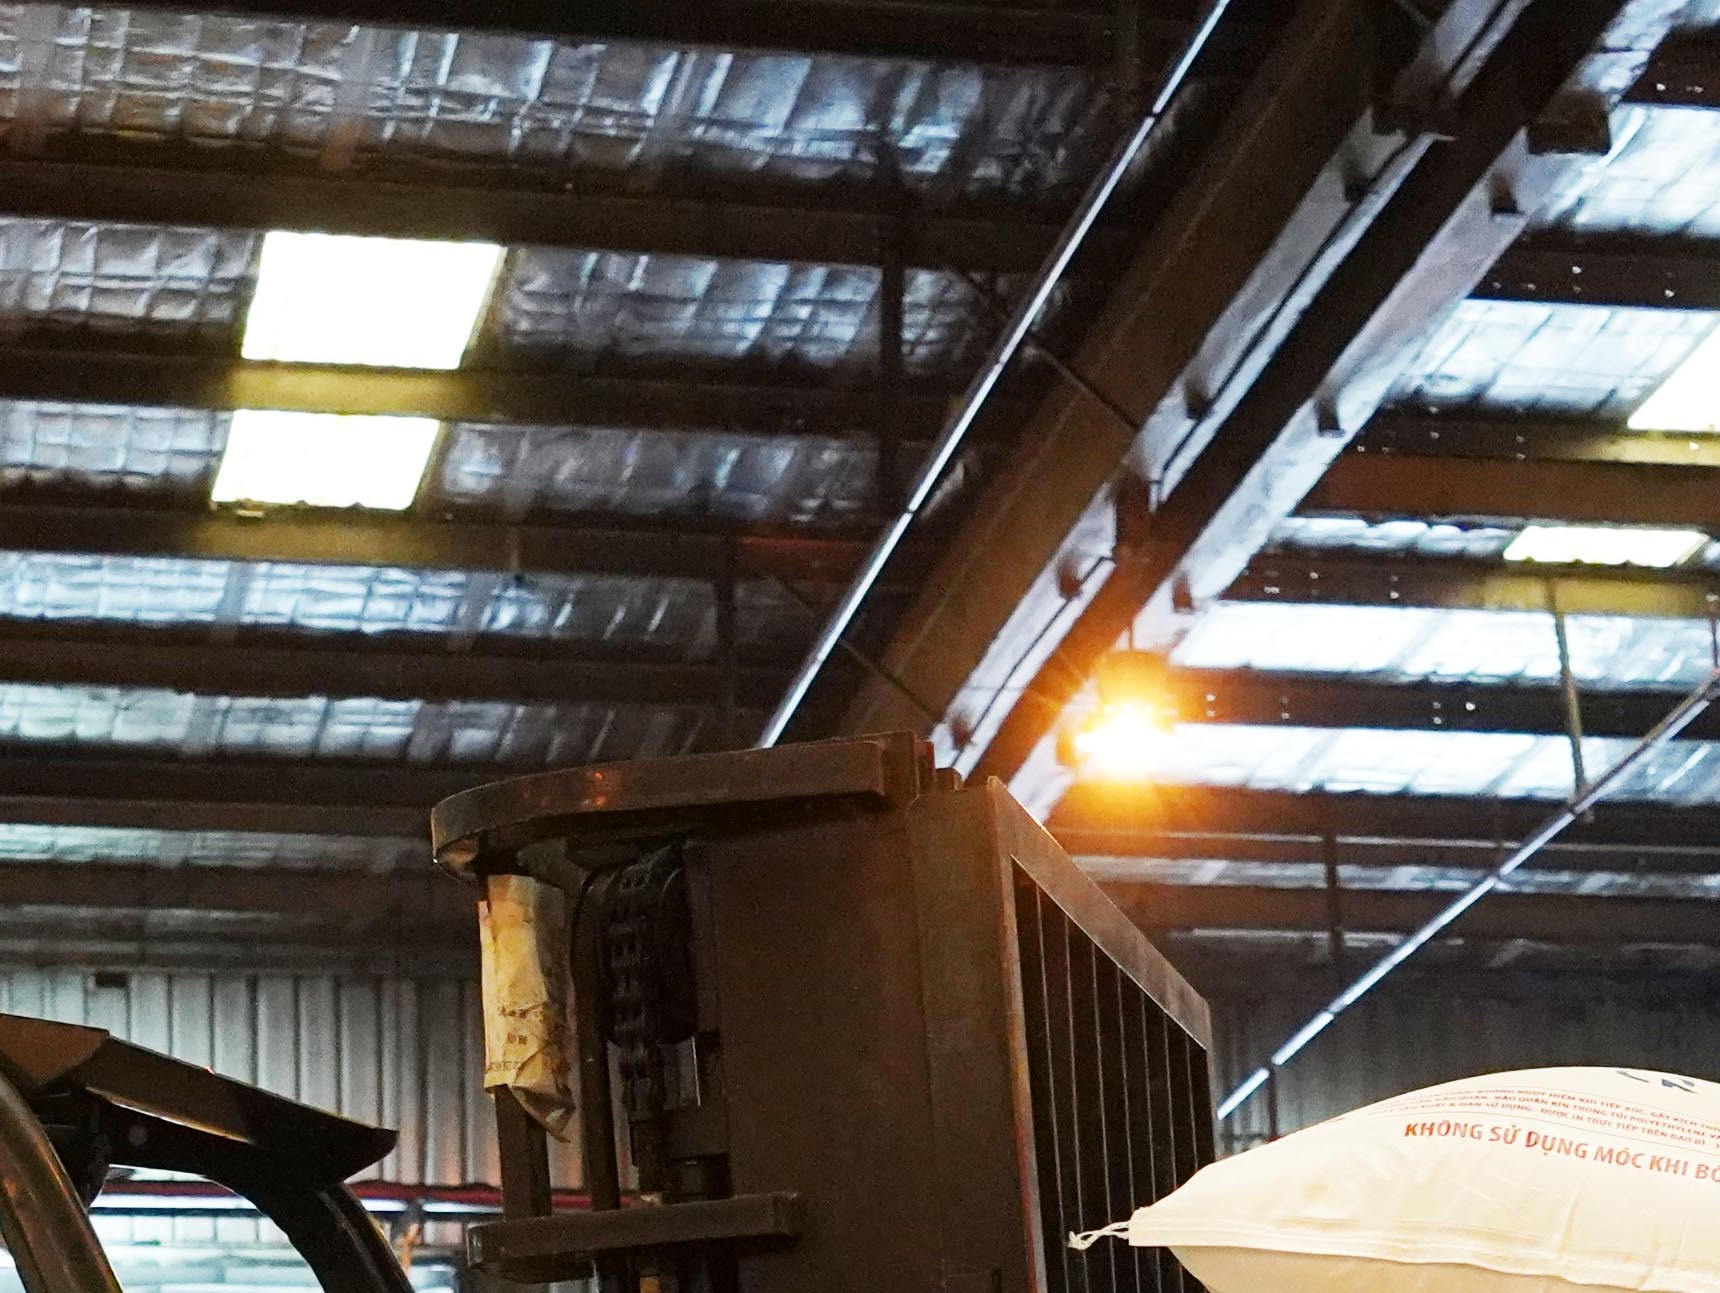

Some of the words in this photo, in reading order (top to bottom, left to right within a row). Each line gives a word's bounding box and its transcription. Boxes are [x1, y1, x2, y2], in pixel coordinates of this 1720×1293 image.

[1404, 1120, 1483, 1140] KHÔNG
[1489, 1122, 1519, 1146] SỬ
[1526, 1130, 1588, 1157] DỤNG
[1593, 1146, 1642, 1169] MÓC
[1649, 1155, 1688, 1177] KHI
